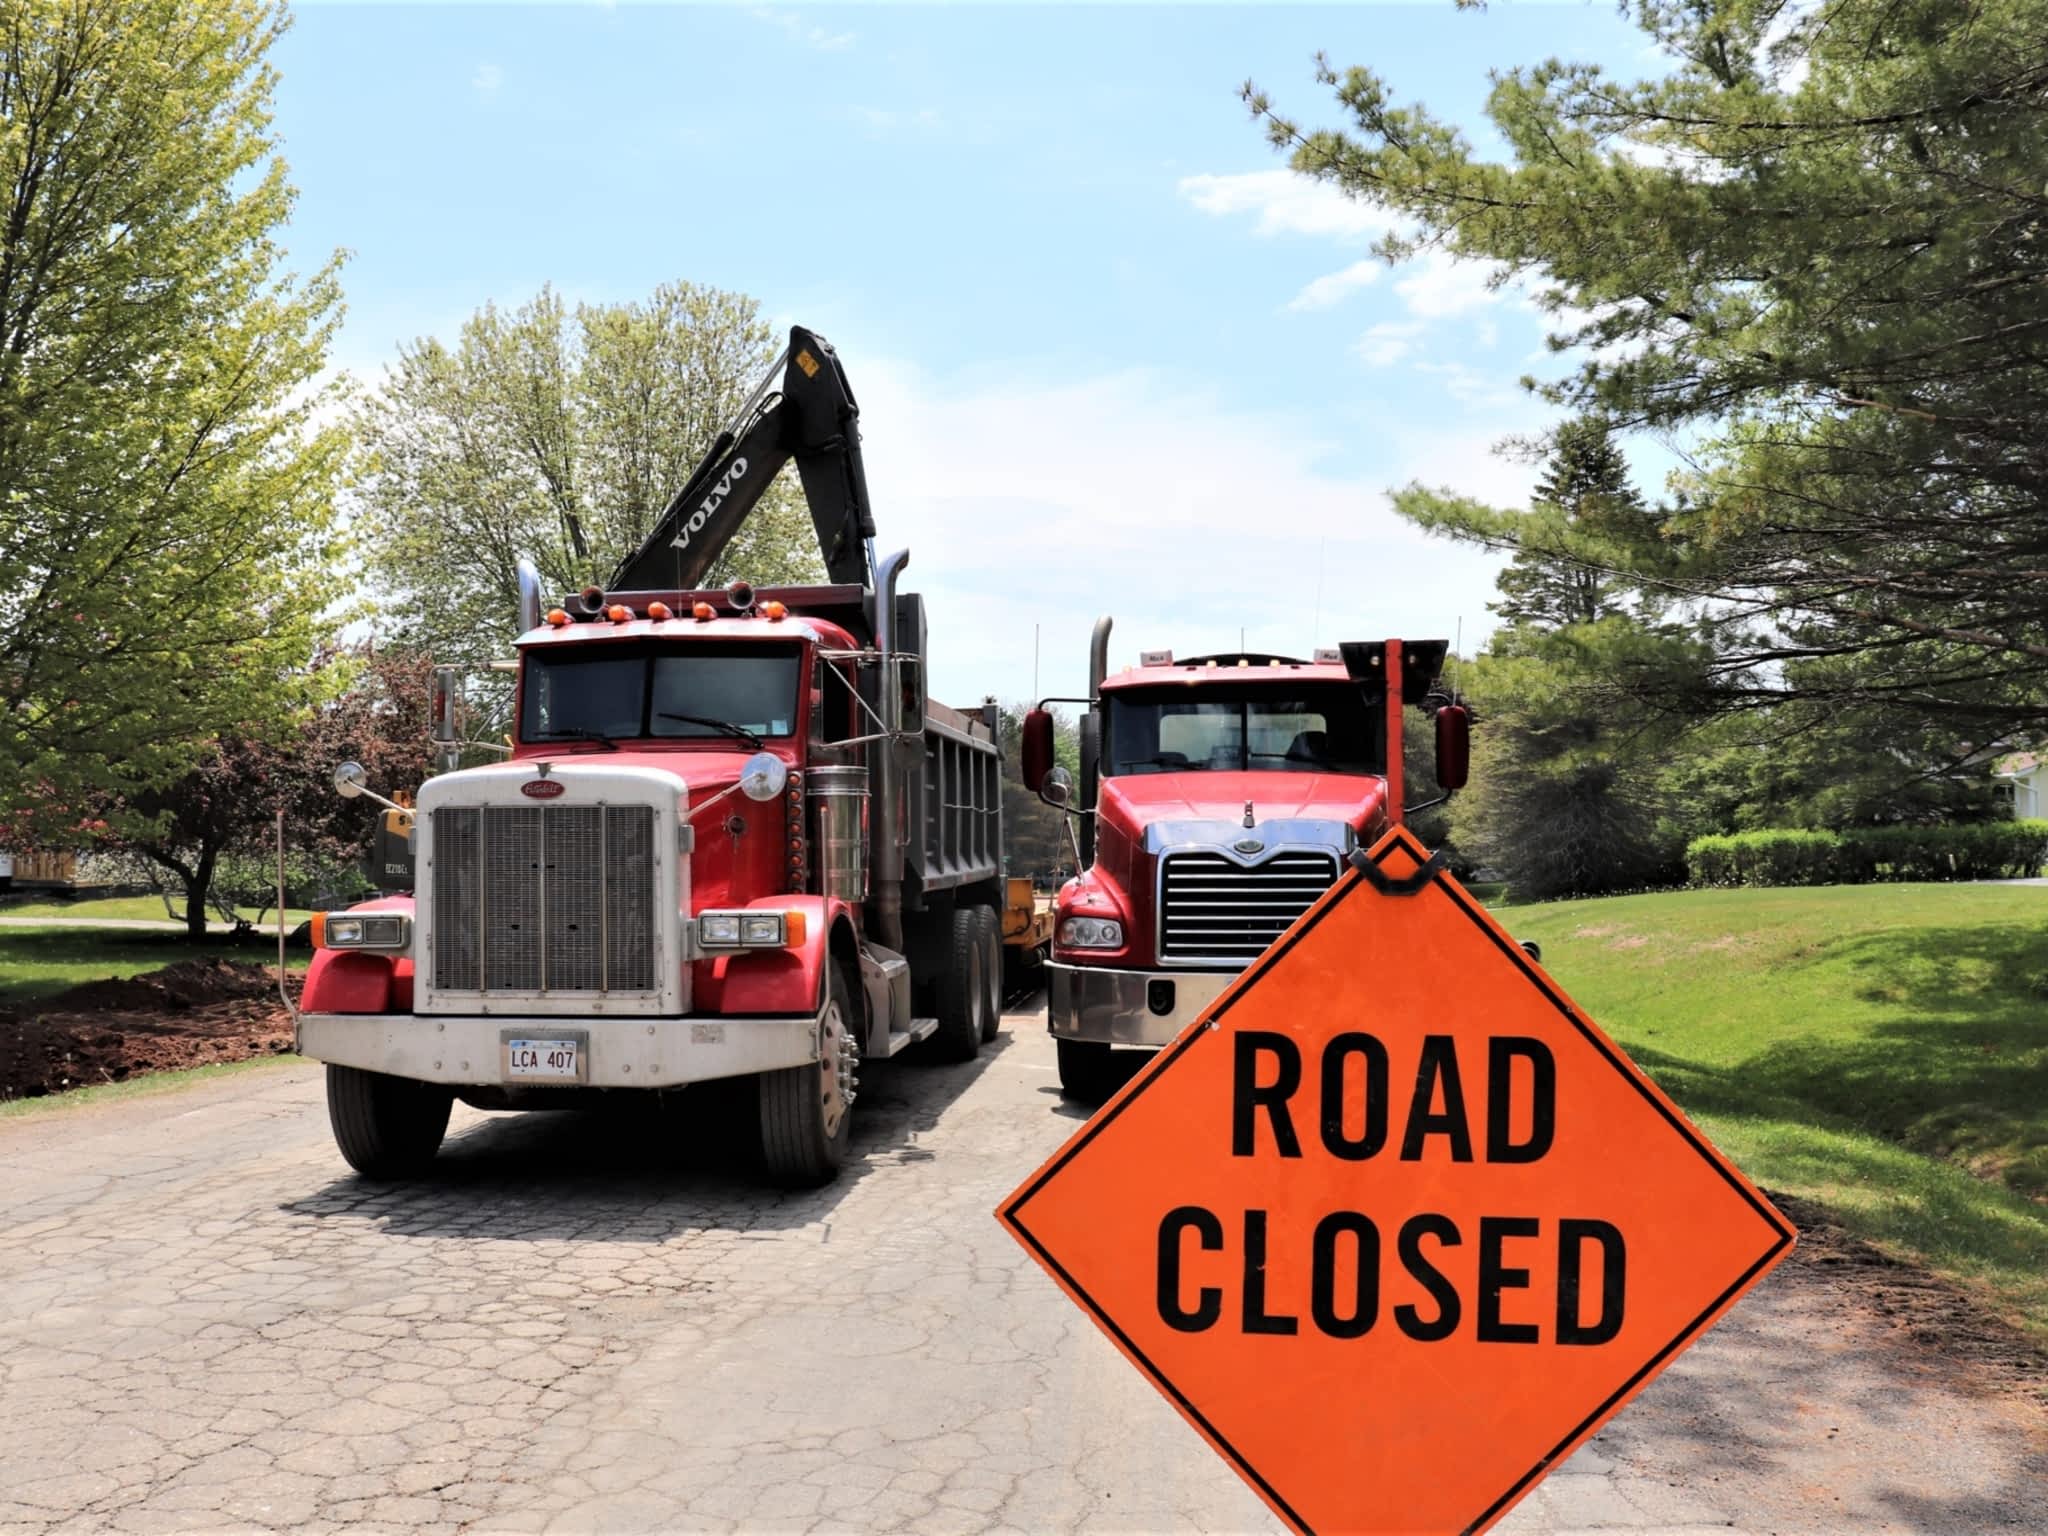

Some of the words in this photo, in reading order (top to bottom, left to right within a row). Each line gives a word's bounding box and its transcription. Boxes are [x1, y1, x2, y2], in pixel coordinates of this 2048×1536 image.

[669, 457, 748, 549] VOLVO
[511, 1050, 538, 1068] LCA
[547, 1051, 574, 1069] 407
[1232, 1030, 1556, 1164] ROAD
[1156, 1206, 1626, 1346] CLOSED
